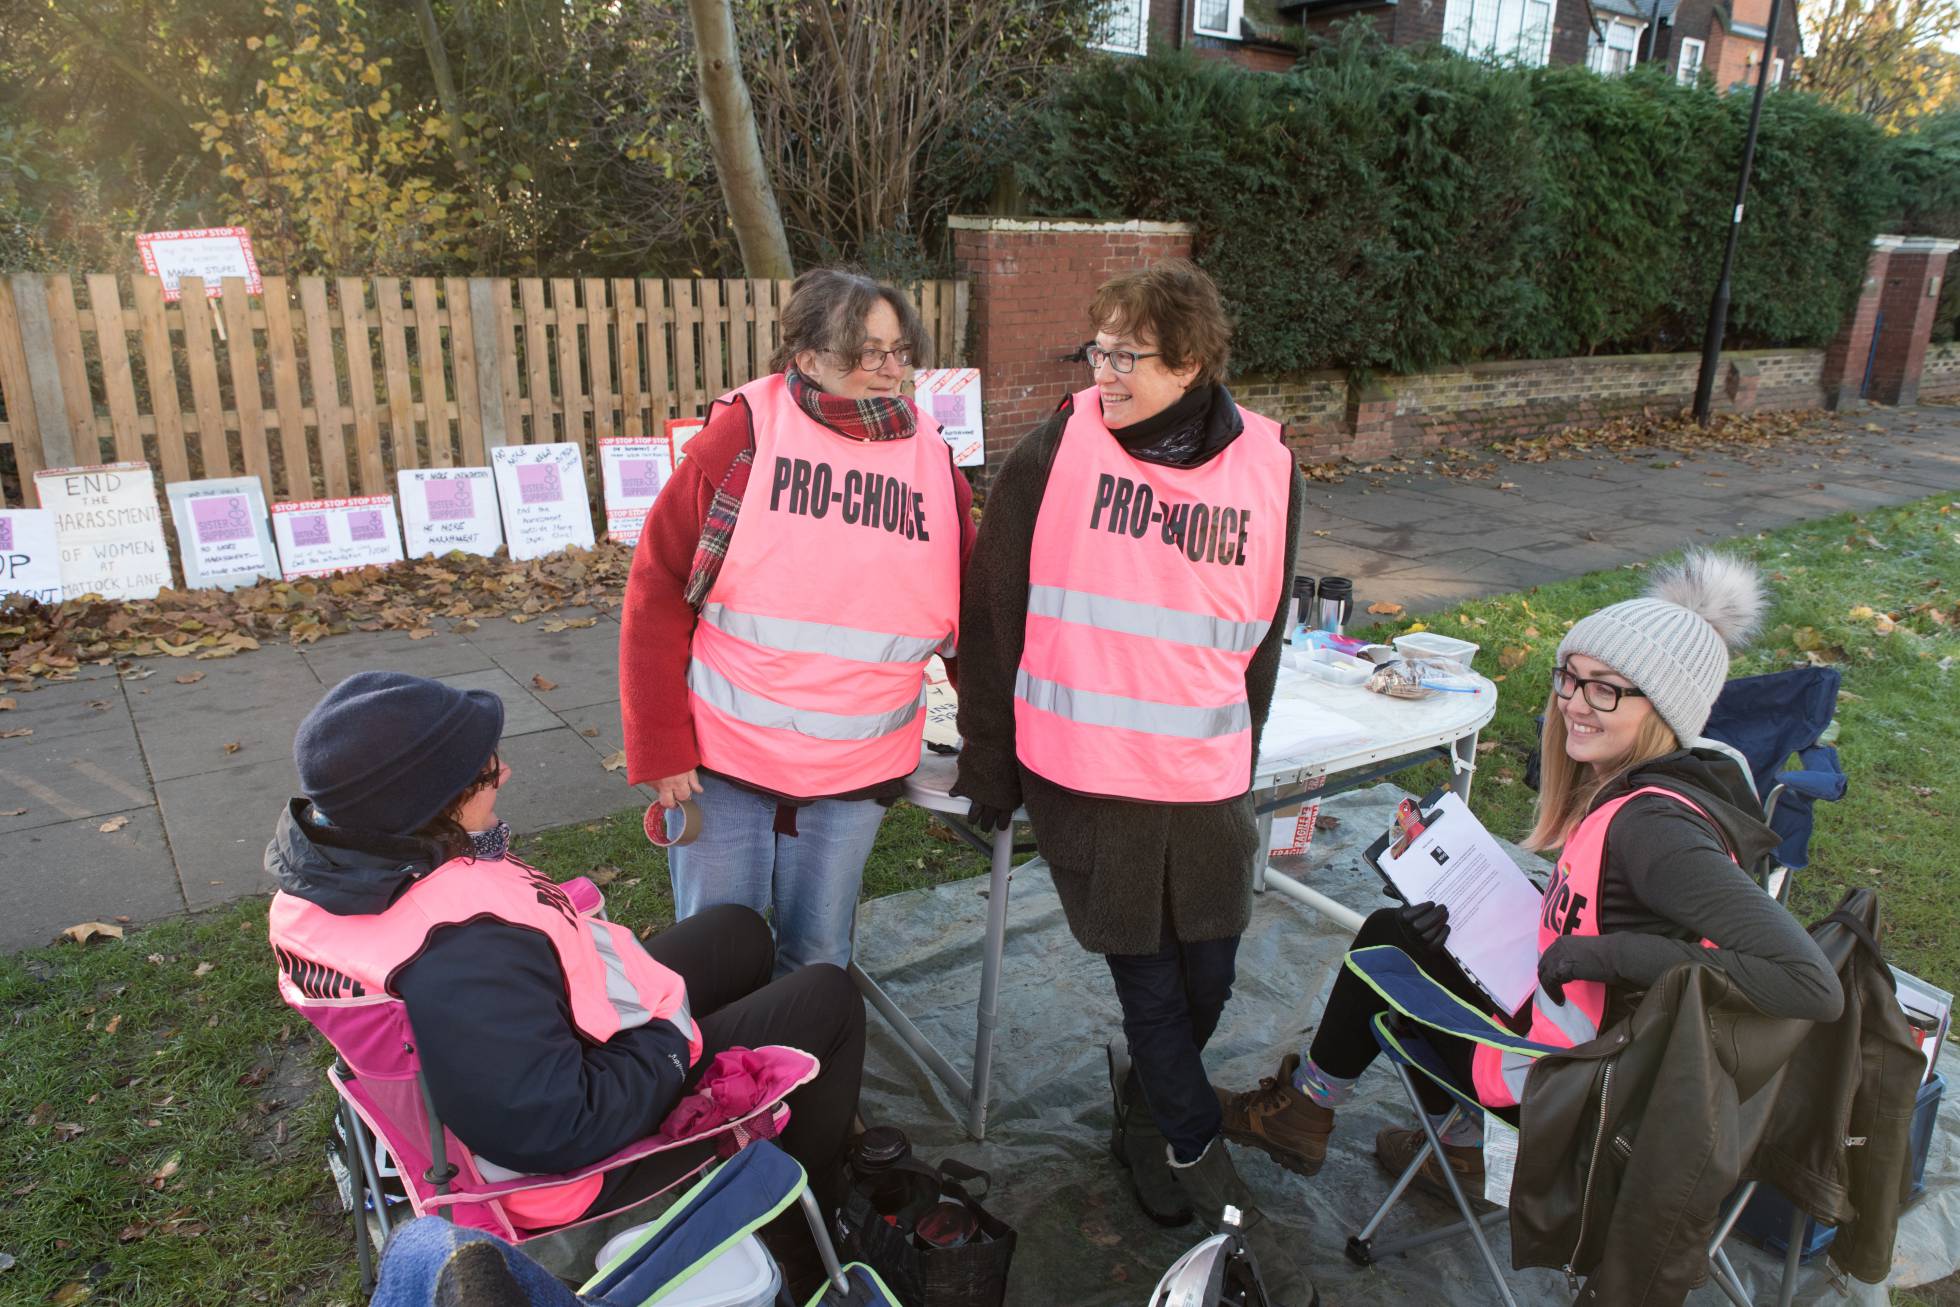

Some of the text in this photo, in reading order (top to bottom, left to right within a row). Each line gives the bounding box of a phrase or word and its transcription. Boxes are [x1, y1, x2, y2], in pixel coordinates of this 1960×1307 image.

[153, 231, 179, 240] STOP
[181, 229, 208, 239] STOP
[208, 228, 234, 237] STOP
[65, 473, 121, 496] END
[82, 495, 110, 505] THE
[275, 503, 299, 511] STOP
[300, 501, 322, 510] STOP
[324, 499, 346, 508] STOP
[347, 497, 370, 507] STOP
[769, 456, 930, 542] PRO-CHOICE
[55, 505, 158, 532] HARASSMENT
[1089, 473, 1251, 567] PRO-CHOICE
[62, 540, 156, 562] OF WOMEN
[100, 561, 115, 572] AT
[61, 573, 164, 597] MATTOCK LANE
